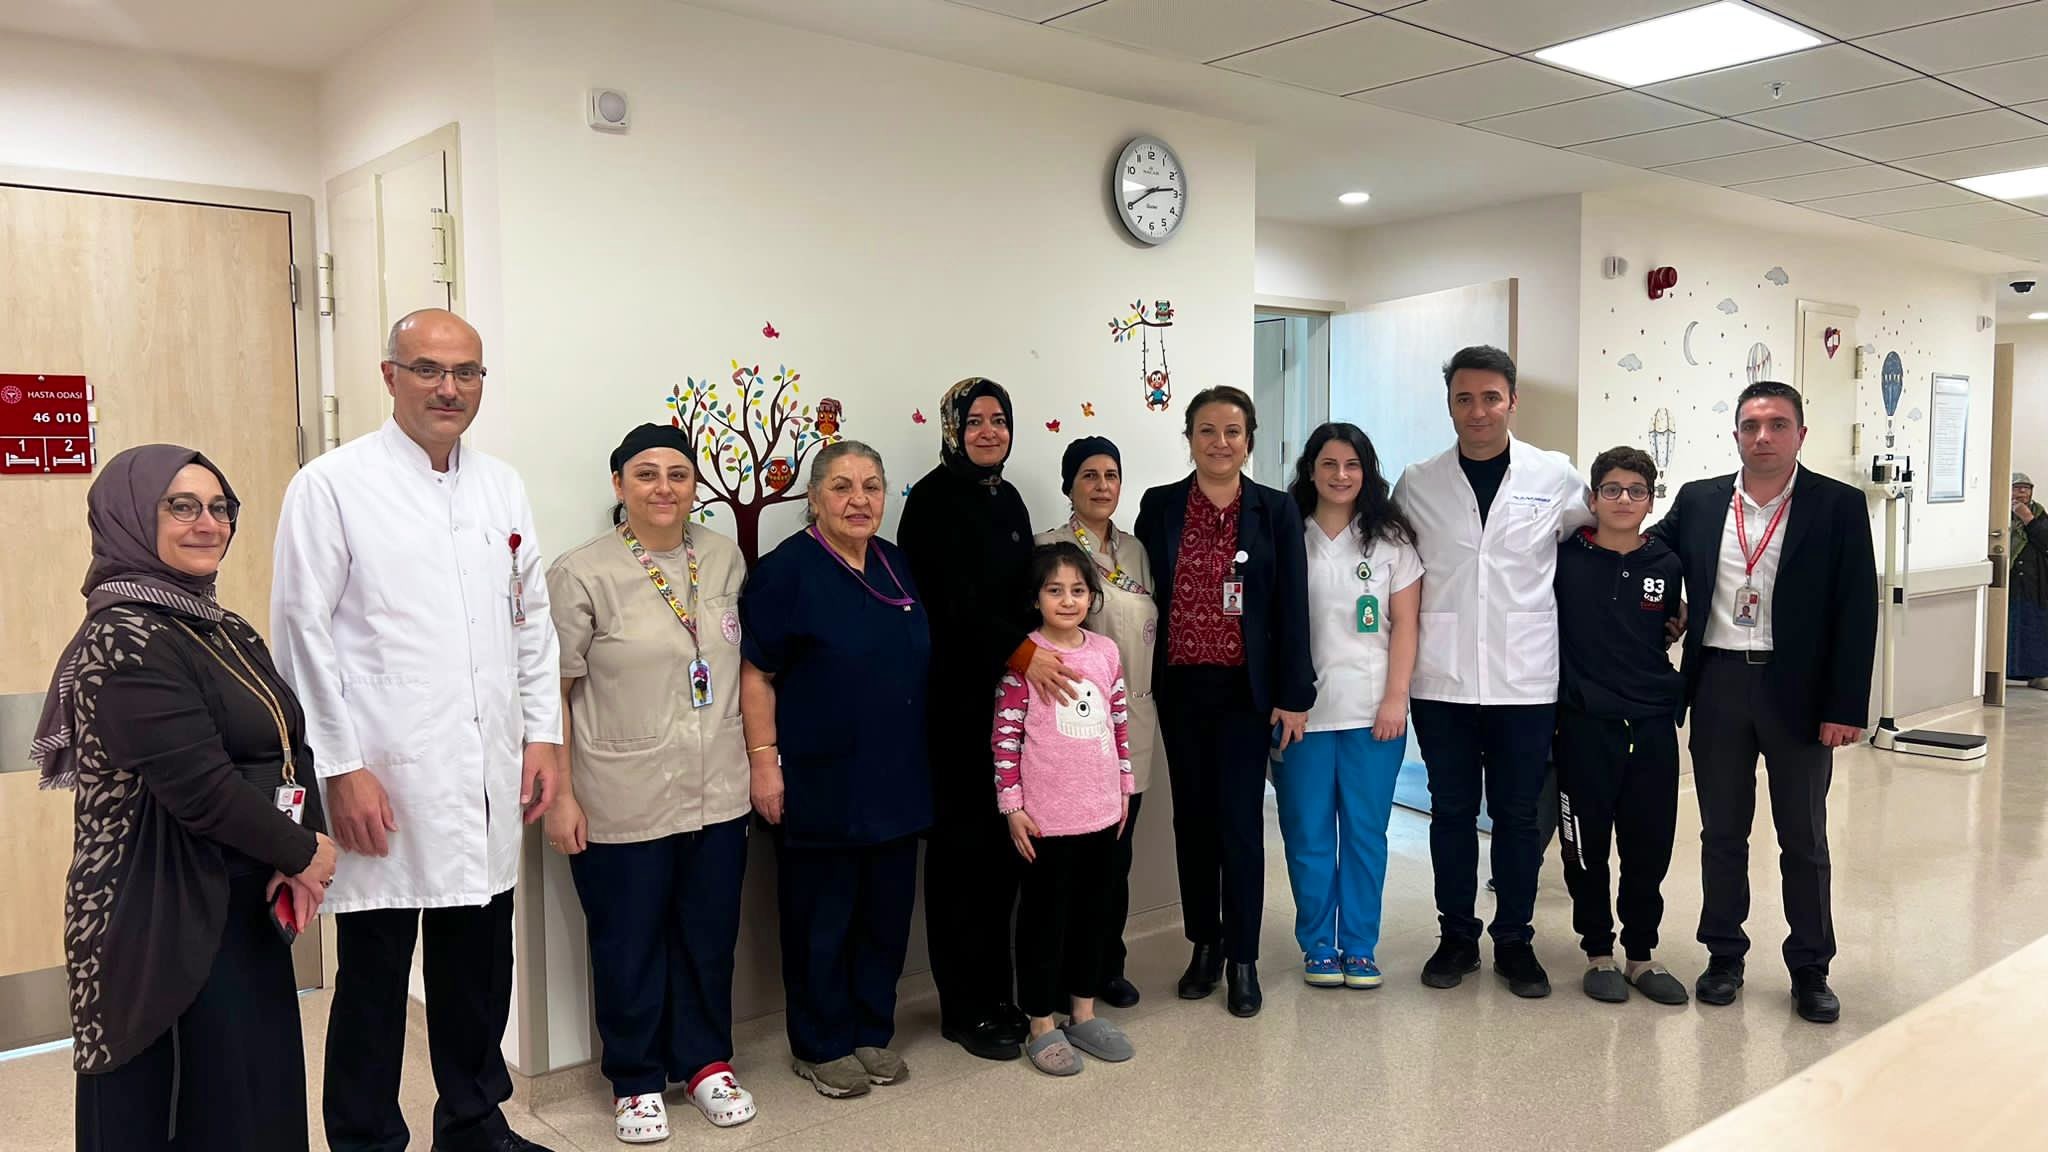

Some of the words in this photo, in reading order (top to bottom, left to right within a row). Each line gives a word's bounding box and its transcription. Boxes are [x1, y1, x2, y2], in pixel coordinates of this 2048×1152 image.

[1147, 151, 1155, 160] 12
[1127, 166, 1136, 175] 10
[1169, 172, 1175, 180] 2
[1173, 190, 1178, 198] 3
[1169, 206, 1175, 215] 4
[1136, 216, 1142, 224] 7
[1161, 218, 1167, 227] 5
[1148, 222, 1155, 230] 6
[27, 391, 55, 399] HASTA
[56, 391, 83, 399] ODASI
[33, 412, 50, 423] 46
[56, 412, 81, 423] 010
[18, 439, 26, 452] 1
[64, 439, 74, 452] 2
[1643, 577, 1665, 594] 83
